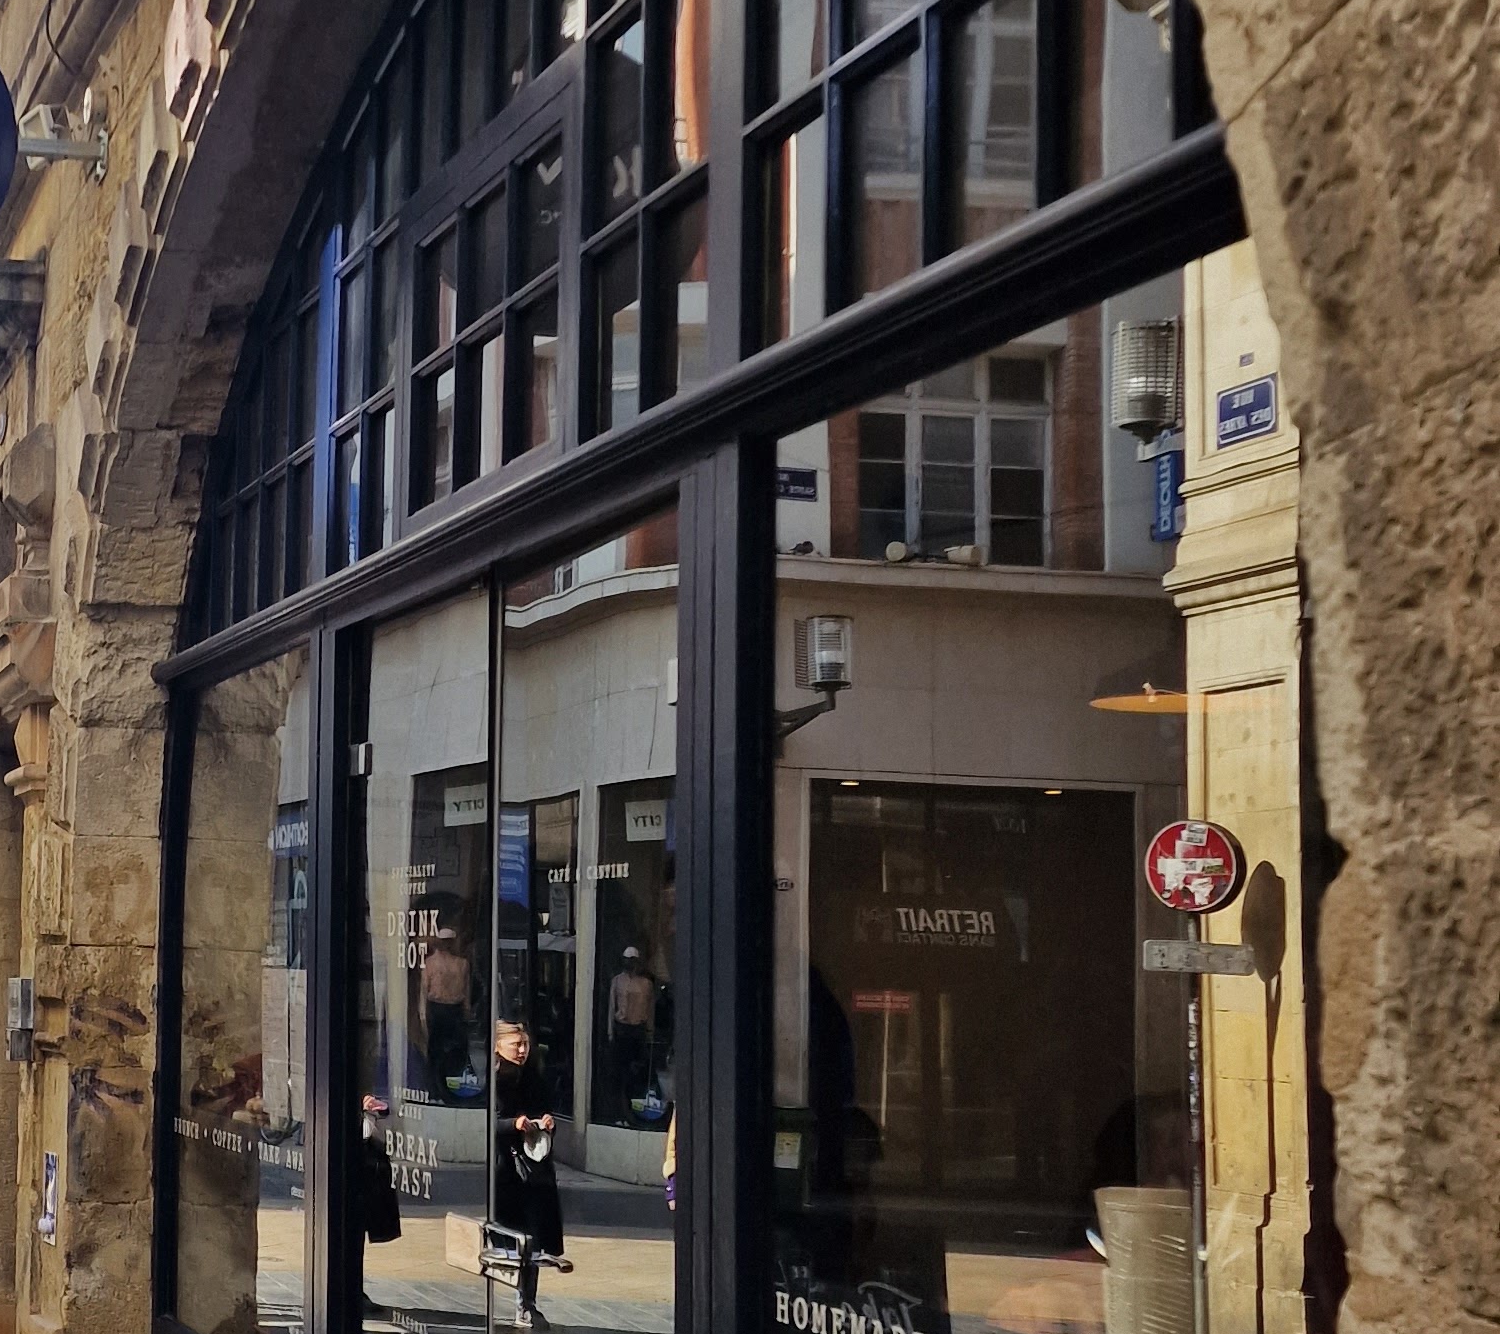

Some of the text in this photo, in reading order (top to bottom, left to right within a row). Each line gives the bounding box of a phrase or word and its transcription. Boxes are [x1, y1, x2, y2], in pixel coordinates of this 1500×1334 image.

[387, 909, 440, 938] DRINK
[397, 941, 429, 970] HOT
[211, 1127, 243, 1154] COFFEE
[257, 1140, 281, 1165] TAKE
[385, 1128, 438, 1168] BREAK
[390, 1162, 432, 1200] FAST
